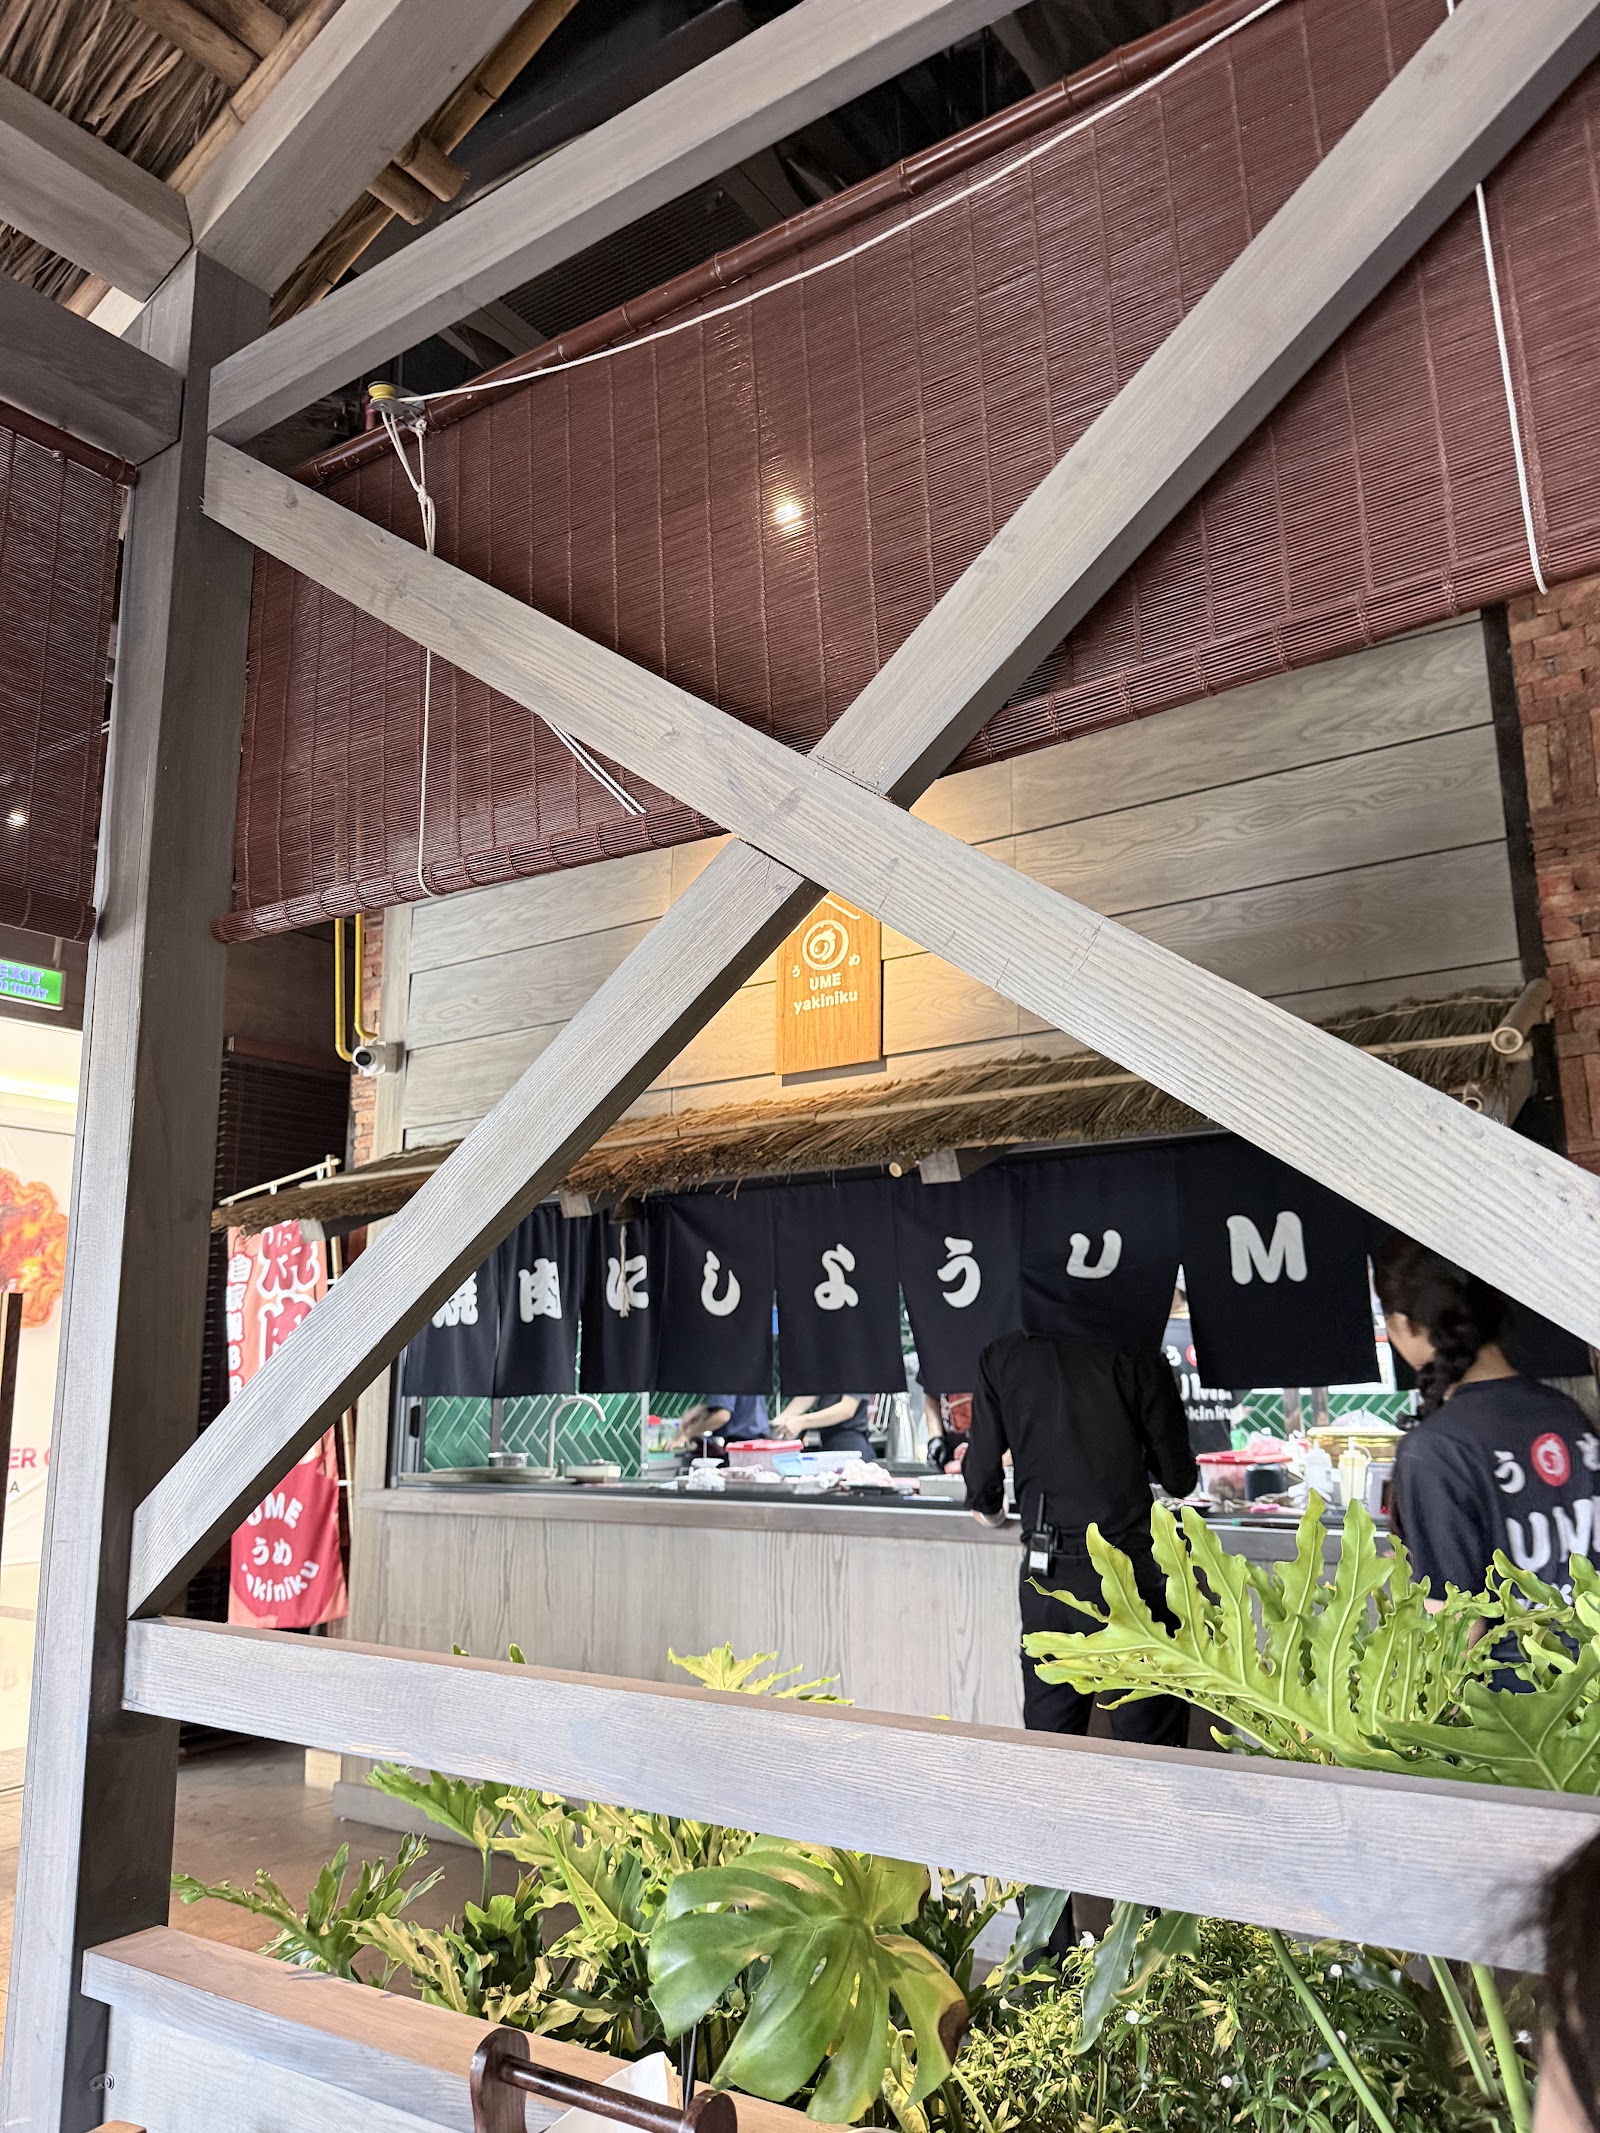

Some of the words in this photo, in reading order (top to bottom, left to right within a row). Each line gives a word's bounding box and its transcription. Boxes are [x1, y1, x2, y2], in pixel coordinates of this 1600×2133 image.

[0, 962, 45, 984] EXIT
[809, 972, 842, 991] UME
[793, 990, 859, 1015] yakiniku
[252, 1537, 292, 1567] うめ
